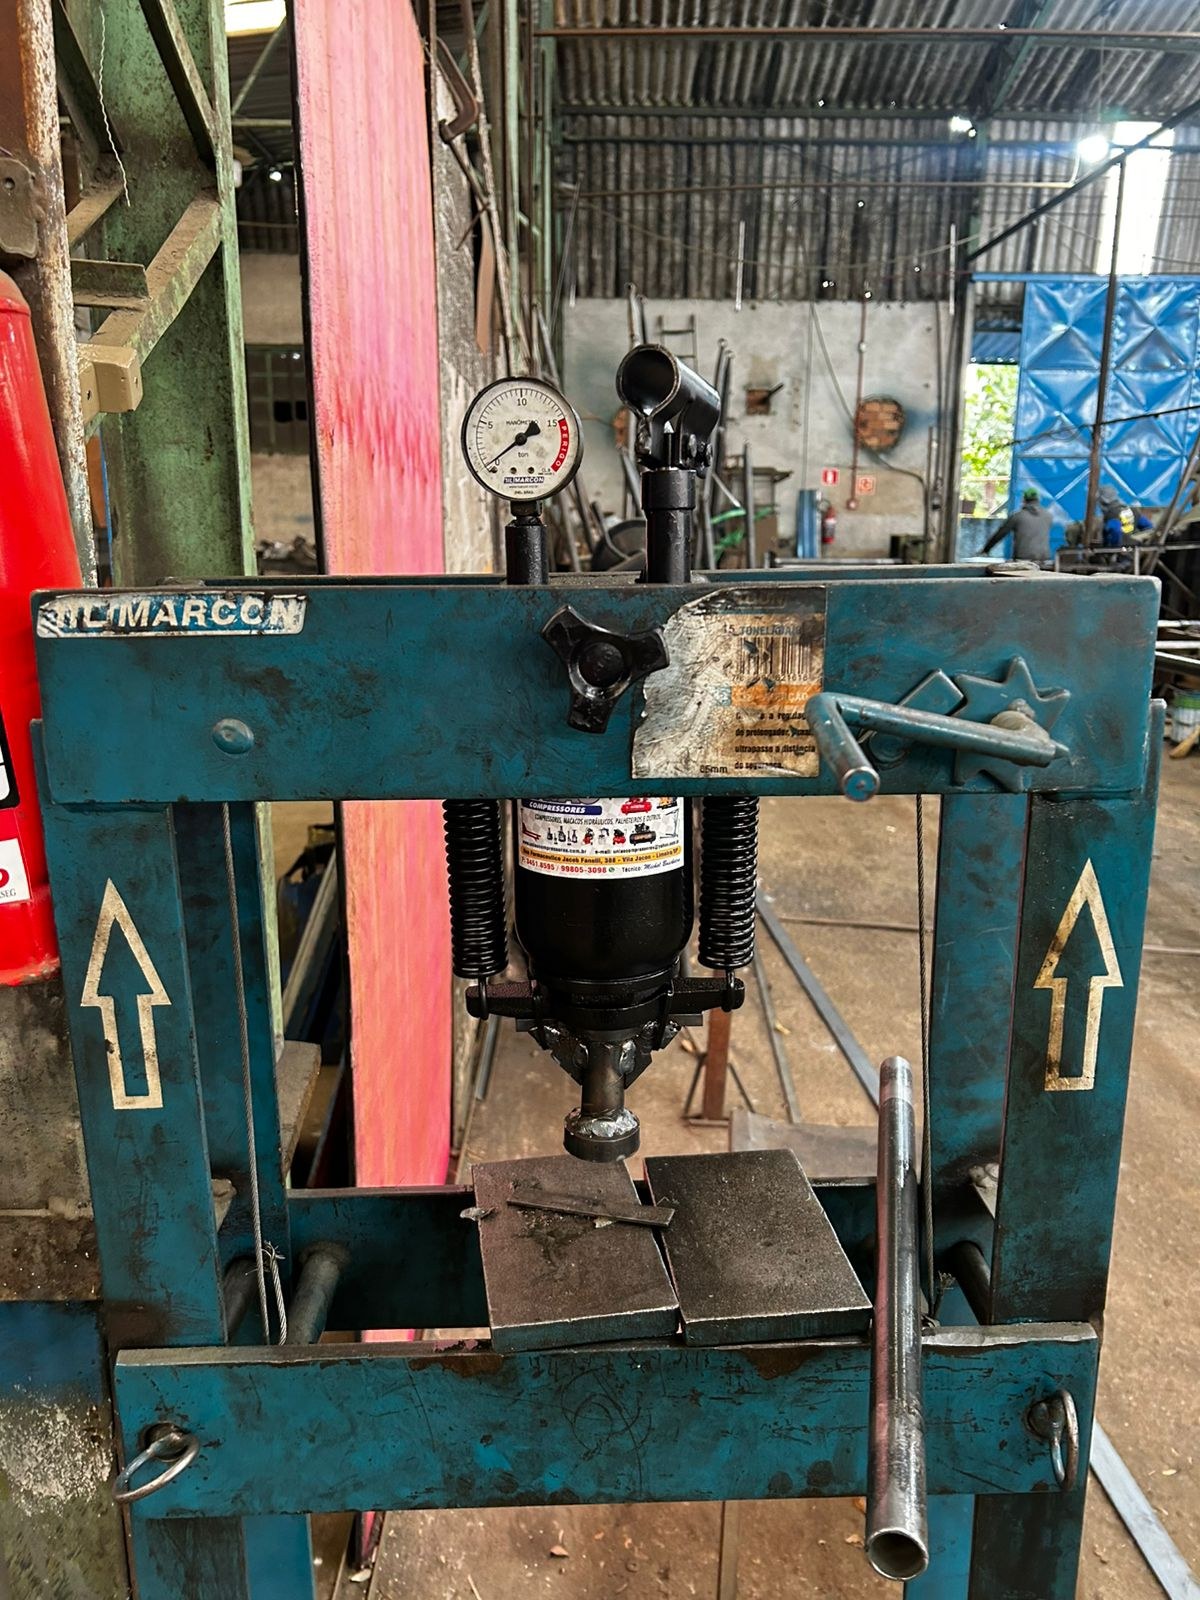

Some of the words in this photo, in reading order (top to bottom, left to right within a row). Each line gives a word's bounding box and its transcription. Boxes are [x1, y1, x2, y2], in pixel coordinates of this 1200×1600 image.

[516, 398, 527, 407] 10
[488, 422, 494, 430] 5
[548, 419, 558, 428] 15
[555, 425, 568, 467] PERIGO
[529, 801, 587, 814] COMPRESSORES
[560, 865, 607, 874] 99805-3098
[0, 887, 17, 899] SEG
